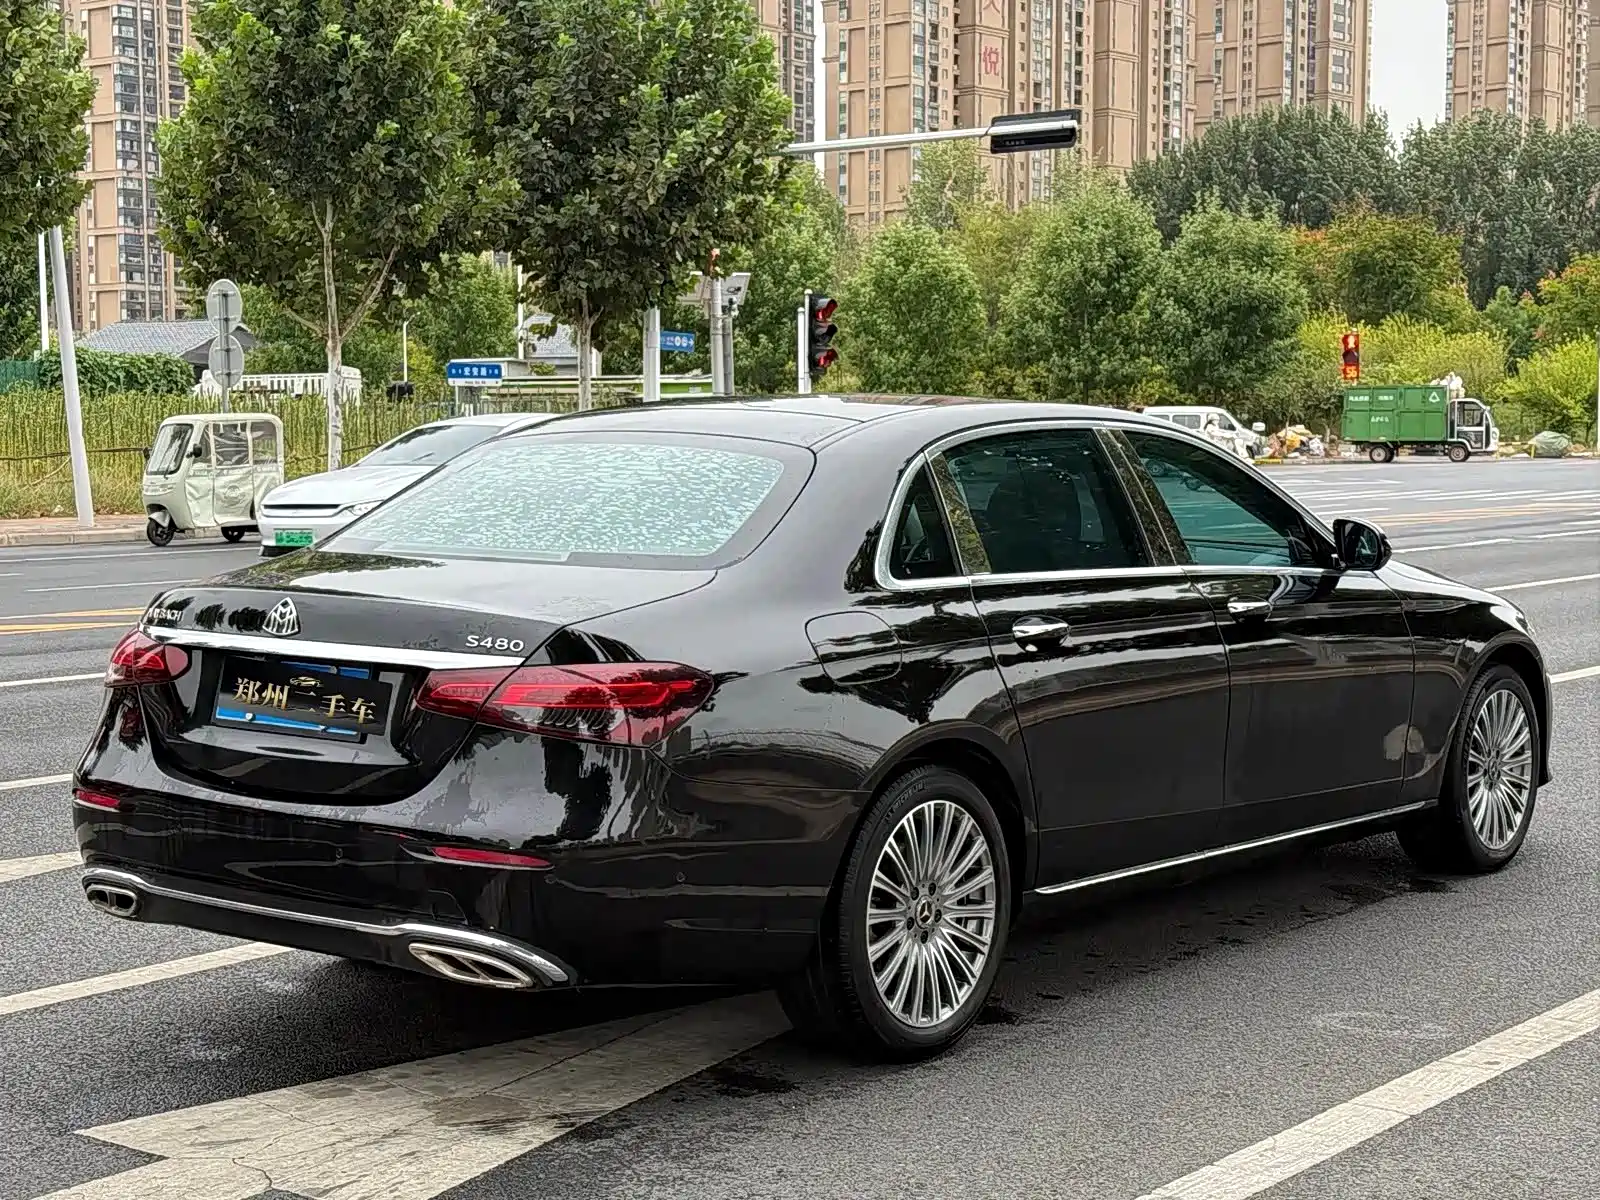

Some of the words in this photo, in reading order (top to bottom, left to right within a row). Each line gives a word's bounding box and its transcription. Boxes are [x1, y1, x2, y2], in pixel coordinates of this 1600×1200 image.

[465, 635, 524, 652] S480
[233, 677, 377, 724] 郑州二手车
